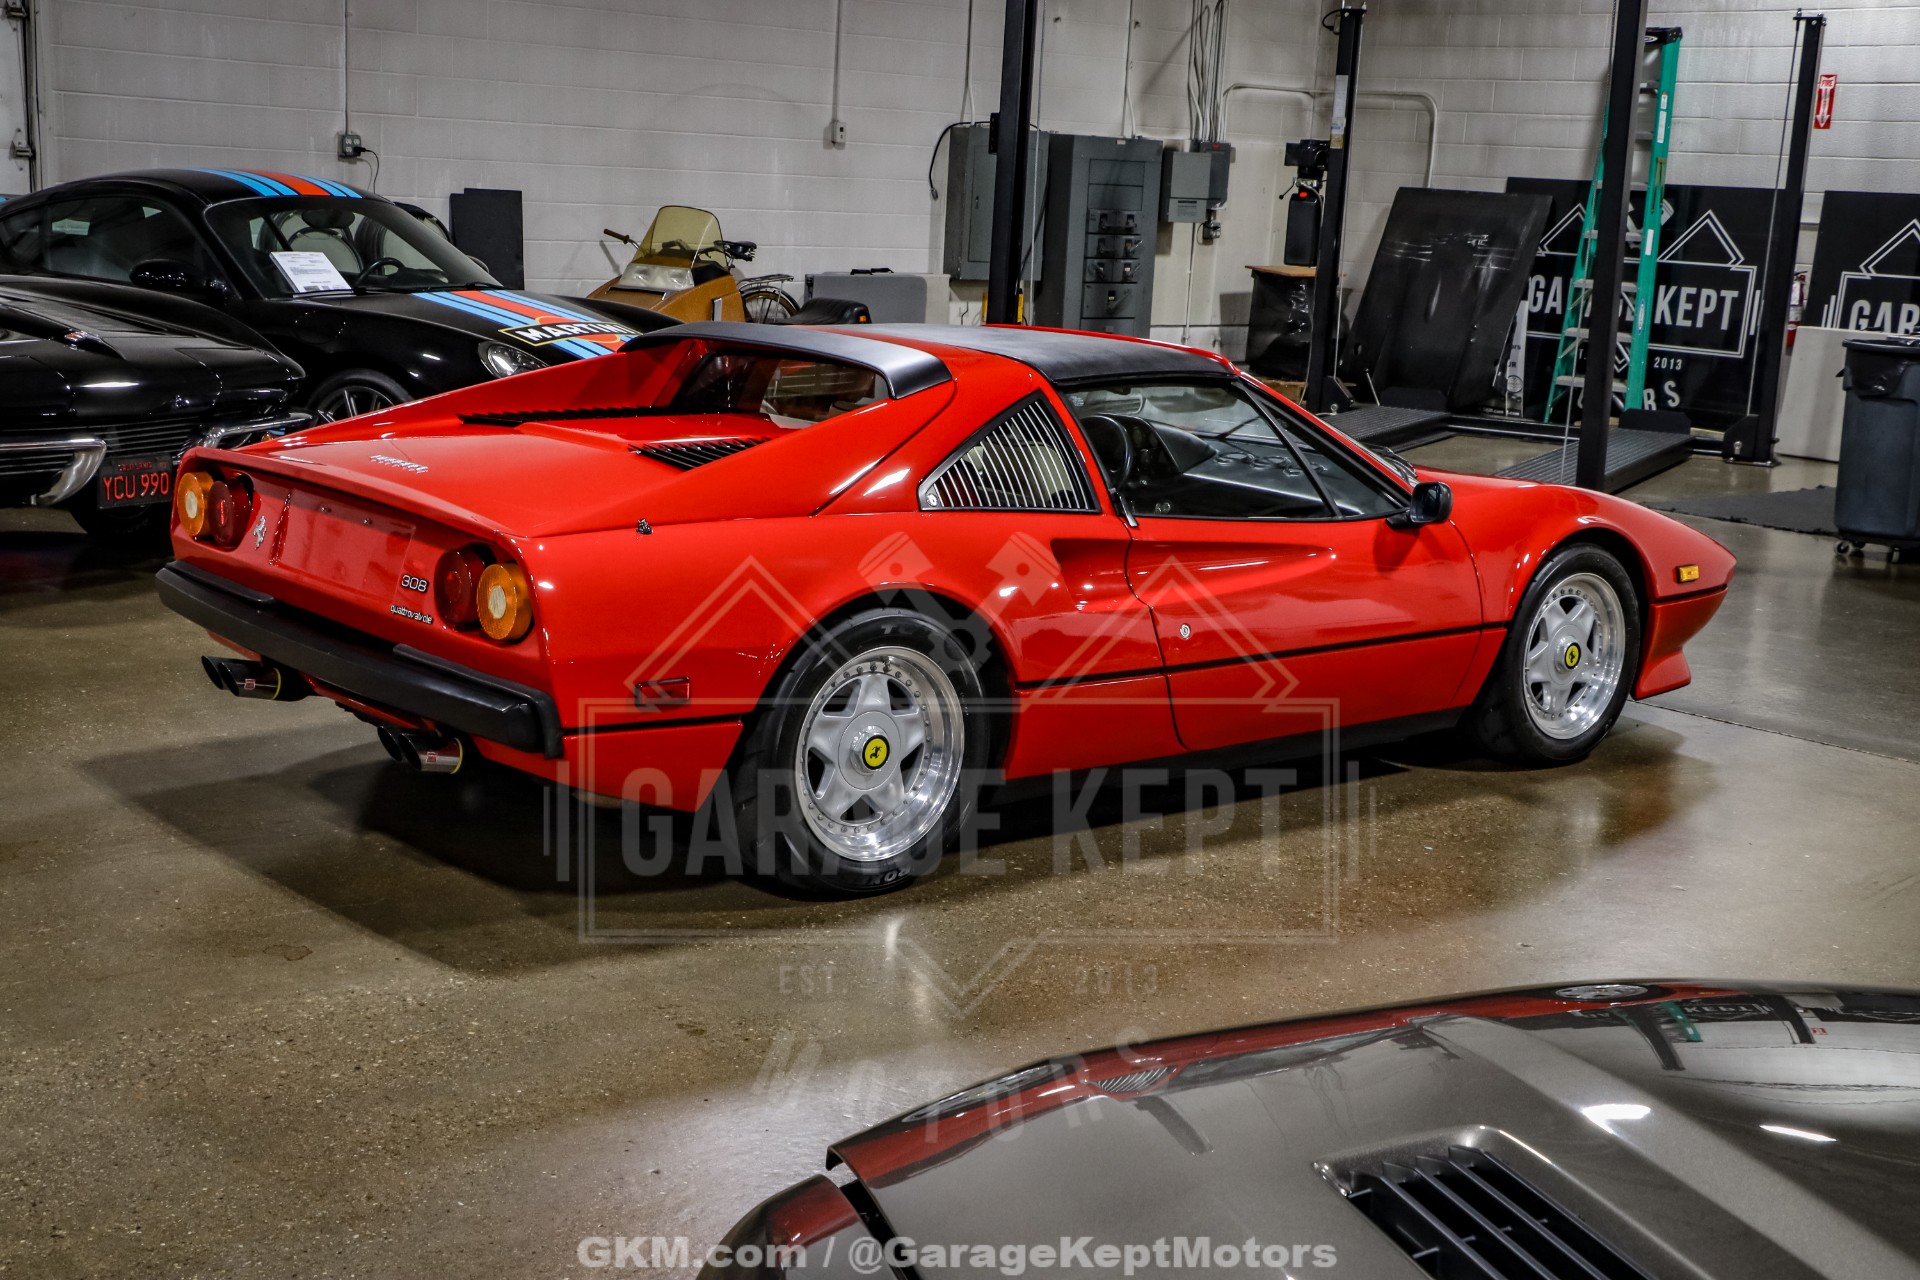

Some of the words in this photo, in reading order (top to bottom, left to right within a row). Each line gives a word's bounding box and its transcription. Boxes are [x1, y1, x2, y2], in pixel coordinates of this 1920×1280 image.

[1653, 284, 1739, 331] KEPT
[515, 322, 637, 341] MARTINI
[1653, 356, 1682, 371] 2013
[102, 474, 136, 501] YCU
[140, 471, 169, 497] 990
[401, 574, 428, 592] 308
